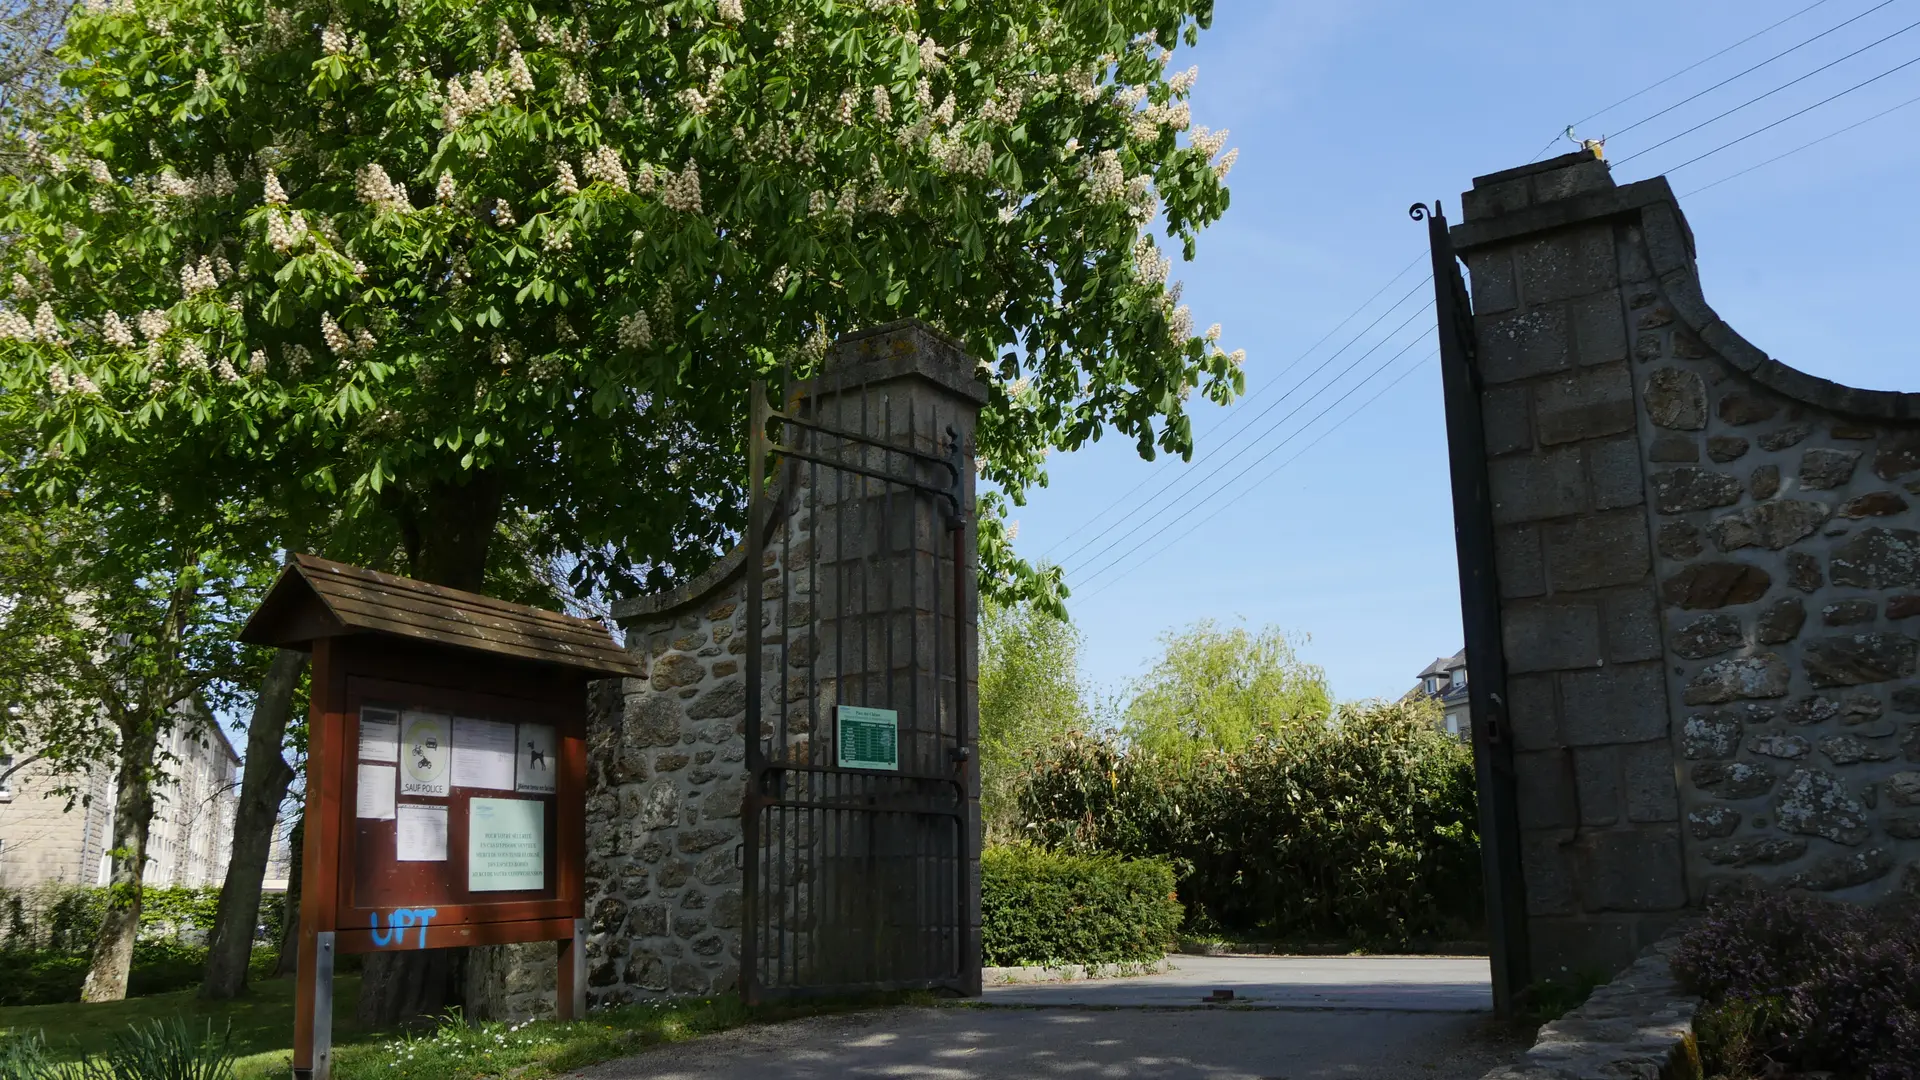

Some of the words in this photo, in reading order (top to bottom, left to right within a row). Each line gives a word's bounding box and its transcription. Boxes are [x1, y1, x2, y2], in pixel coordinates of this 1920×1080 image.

[405, 783, 421, 792] SAUF
[422, 784, 443, 793] POLICE
[371, 908, 437, 949] UPT
